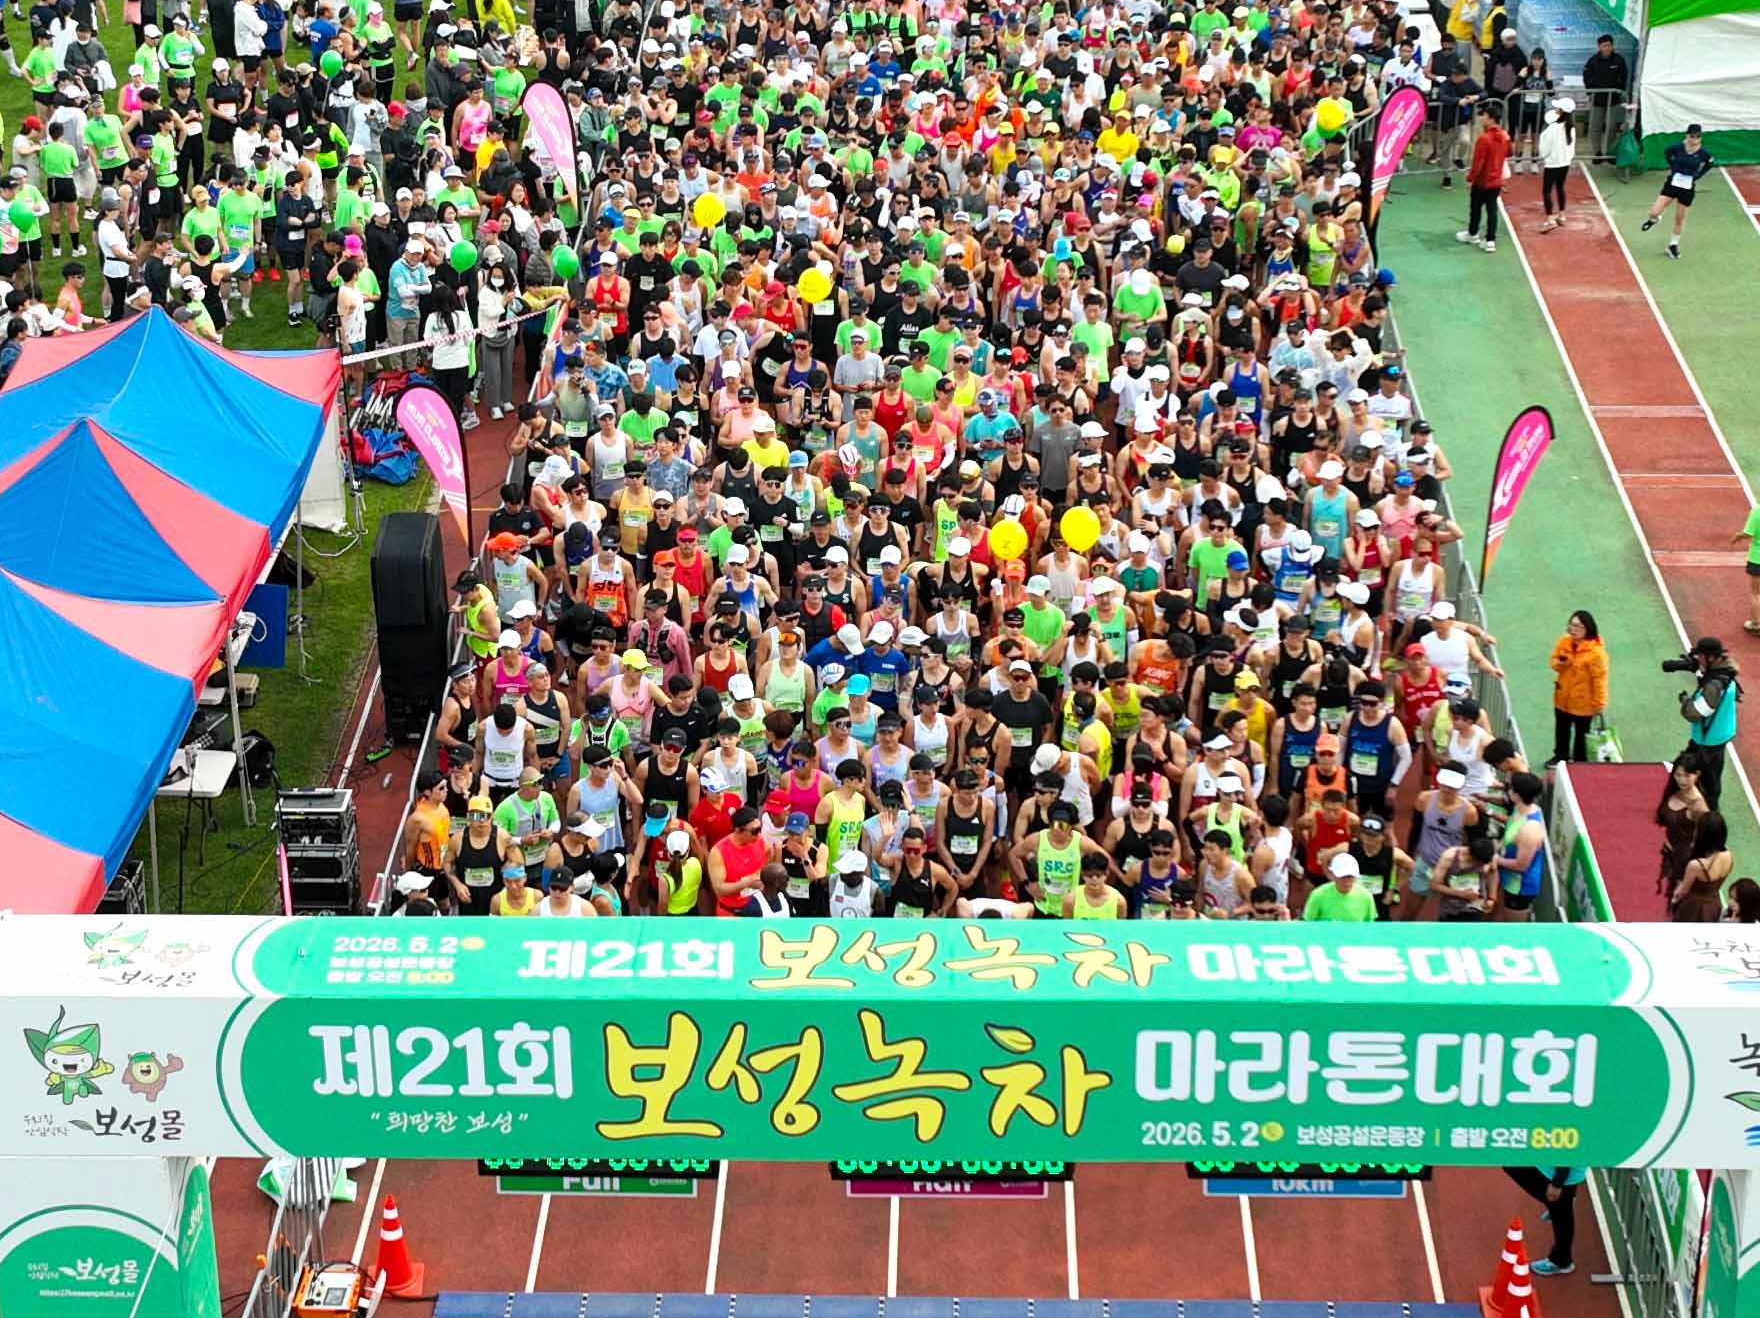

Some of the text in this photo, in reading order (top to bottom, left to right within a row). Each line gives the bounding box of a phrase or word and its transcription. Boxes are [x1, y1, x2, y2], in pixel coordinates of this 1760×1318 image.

[334, 937, 401, 954] 2026.
[438, 937, 458, 954] 2
[518, 925, 1561, 990] 제21회 보성녹차 마라톤대회
[308, 1009, 1598, 1143] 제21회 보성녹차 마라톤대회
[95, 1107, 186, 1143] 보성몰
[1141, 1121, 1260, 1147] 2026. 5. 2
[1297, 1125, 1425, 1149] 보성공설운동장
[1450, 1127, 1579, 1150] 출발 오전 8:00
[76, 1257, 140, 1285] 보성몰
